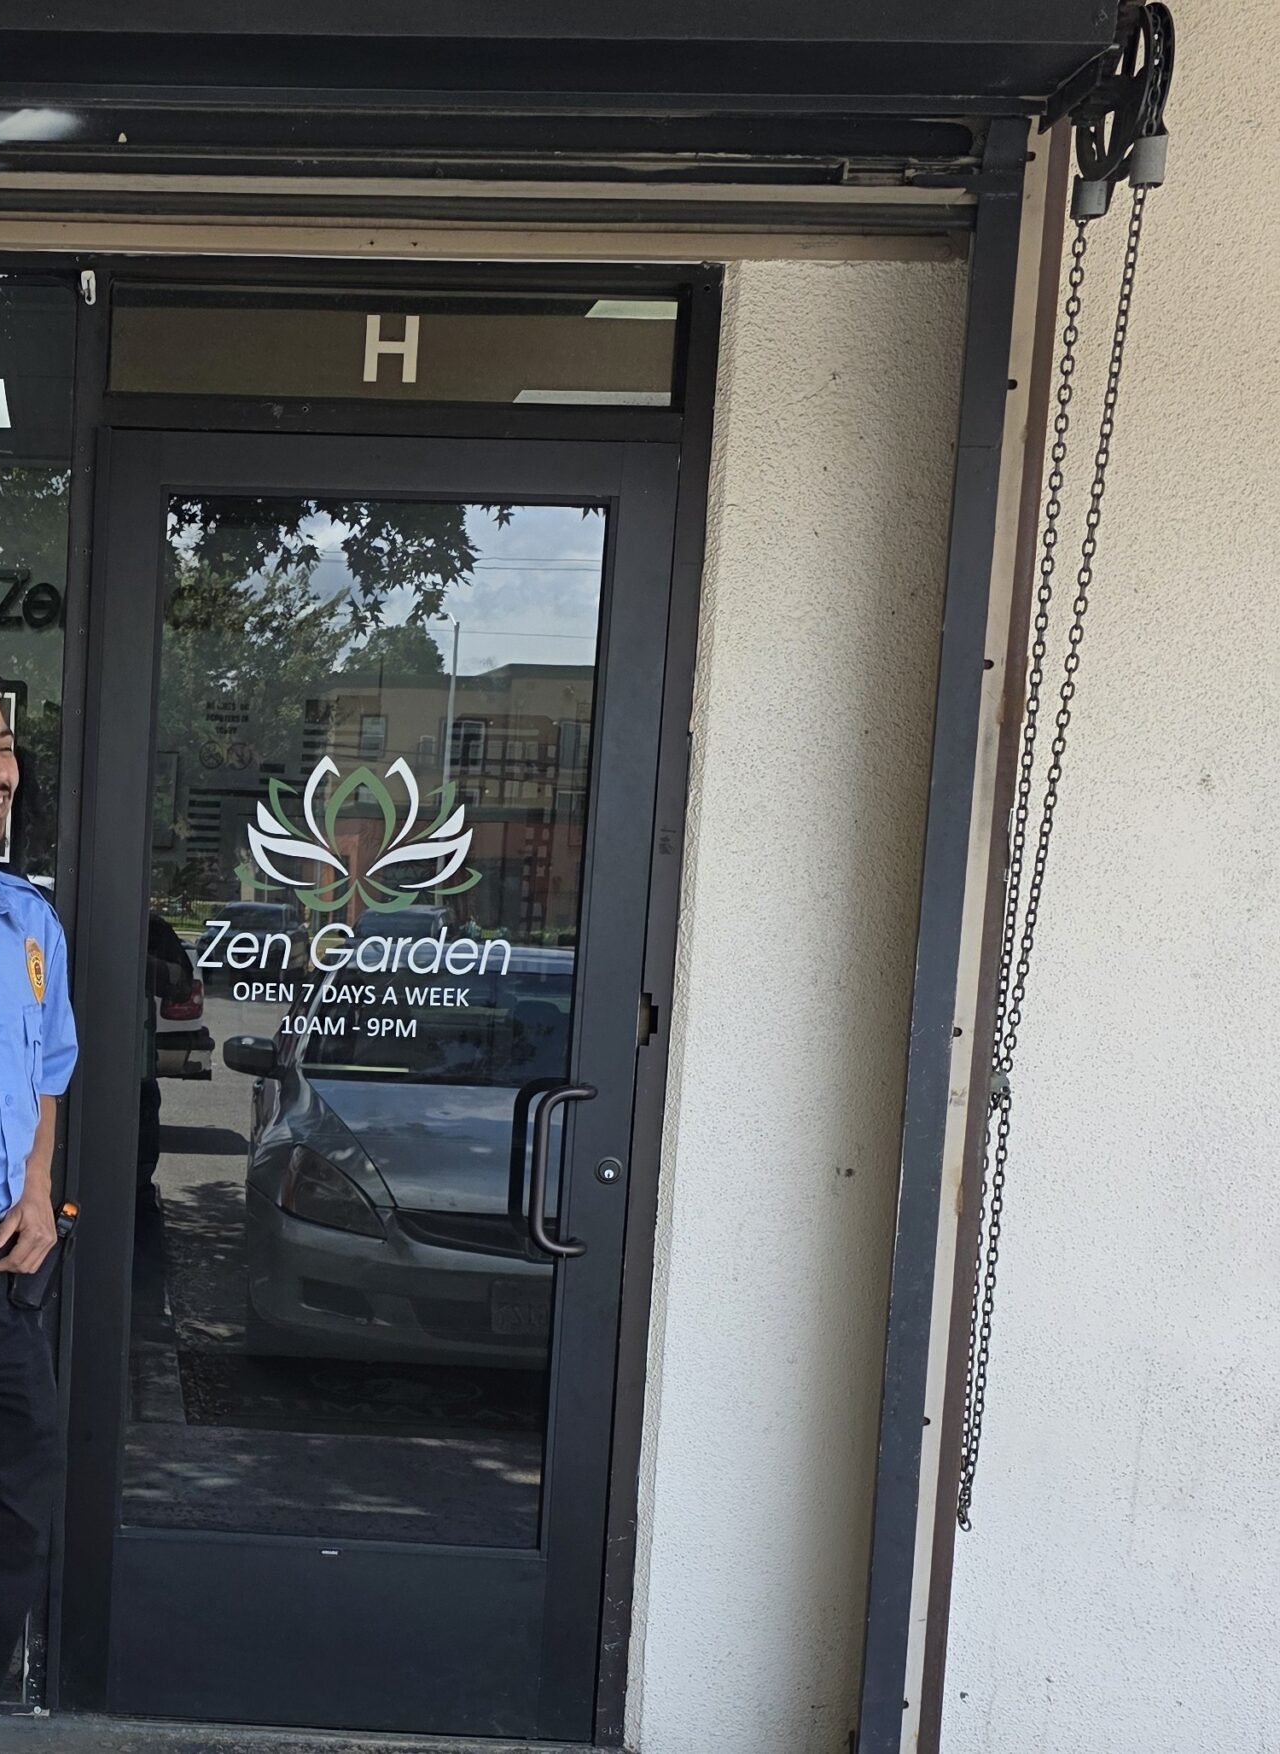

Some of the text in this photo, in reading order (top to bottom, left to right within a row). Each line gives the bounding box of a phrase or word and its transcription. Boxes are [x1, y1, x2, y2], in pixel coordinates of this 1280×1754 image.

[363, 314, 420, 383] H
[197, 920, 512, 976] Zen Garden
[233, 981, 470, 1007] OPEN 7 DAYS A WEEK
[280, 1015, 346, 1036] 10AM
[367, 1017, 418, 1038] 9PM
